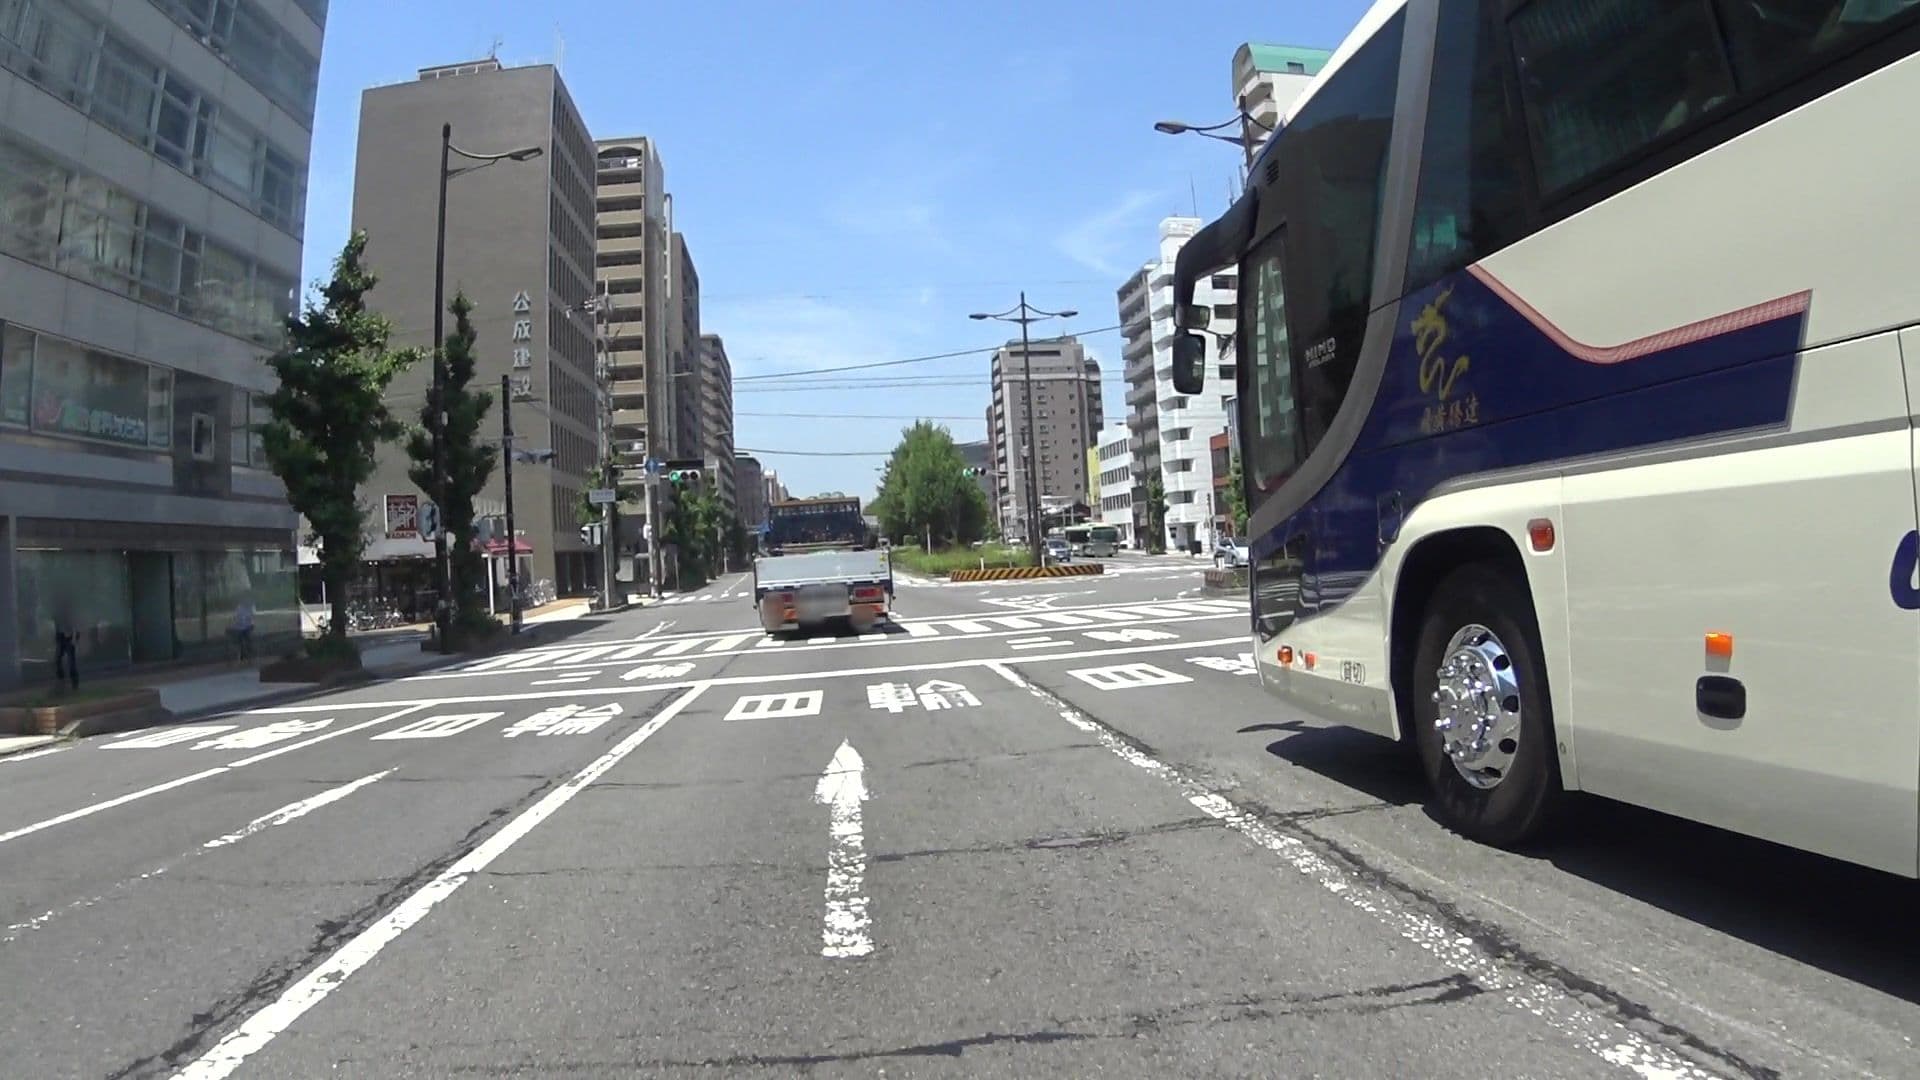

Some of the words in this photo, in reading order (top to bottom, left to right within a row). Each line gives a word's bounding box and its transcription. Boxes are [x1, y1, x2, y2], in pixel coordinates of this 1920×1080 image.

[512, 290, 532, 397] 公成建設
[369, 702, 624, 740] 四輪
[723, 679, 983, 722] 四輪
